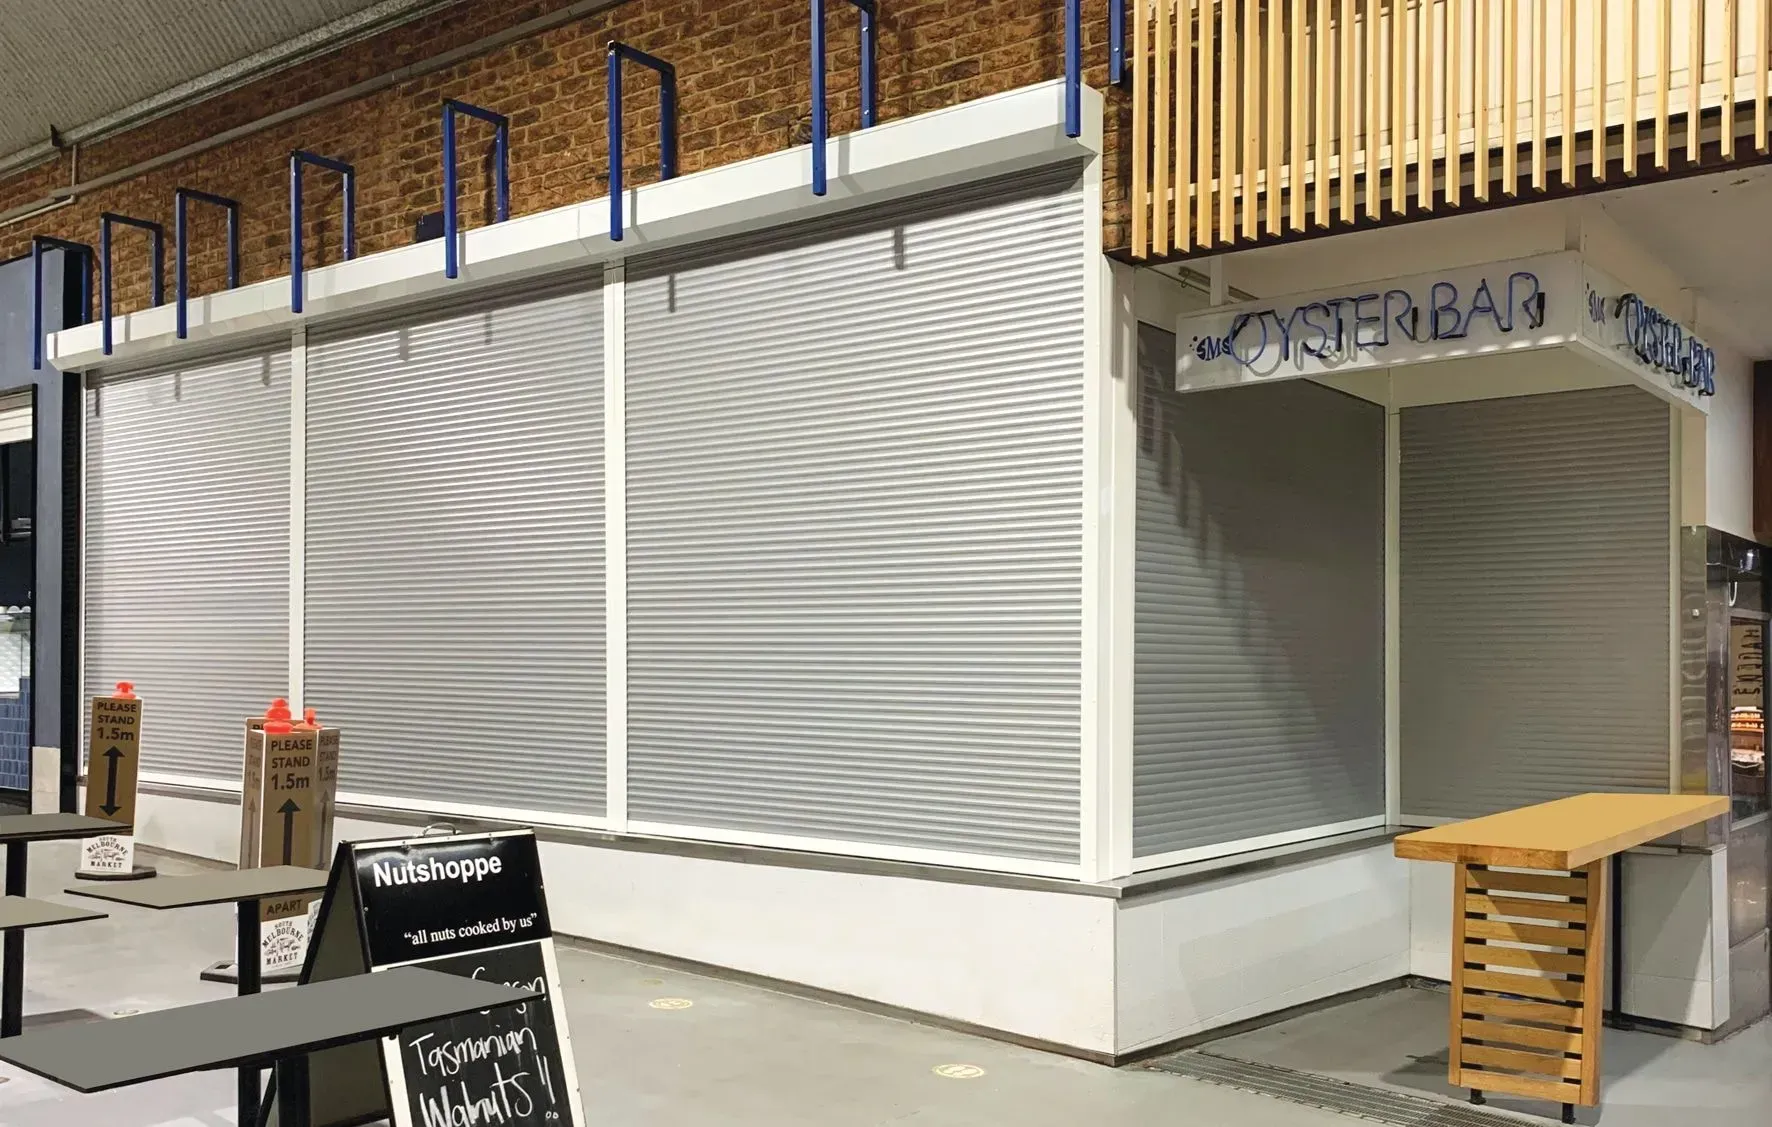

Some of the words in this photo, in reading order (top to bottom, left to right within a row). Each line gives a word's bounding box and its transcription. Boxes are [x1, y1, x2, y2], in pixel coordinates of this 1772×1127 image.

[1229, 290, 1413, 366] OYSTER
[1430, 271, 1541, 341] BAR
[97, 701, 137, 713] PLEASE
[97, 714, 135, 725] STAND
[96, 727, 135, 741] 1.5m
[271, 739, 313, 751] PLEASE
[271, 756, 311, 769] STAND
[271, 772, 310, 790] 1.5m
[86, 841, 128, 856] MELBOURNE
[372, 856, 503, 887] Nutshoppe
[266, 899, 303, 916] APART
[262, 926, 304, 948] MELBOURNE
[430, 928, 456, 942] nuts
[458, 918, 501, 938] cooked
[501, 917, 518, 933] by
[266, 952, 298, 965] MARKET
[408, 1024, 538, 1077] Tasmanian
